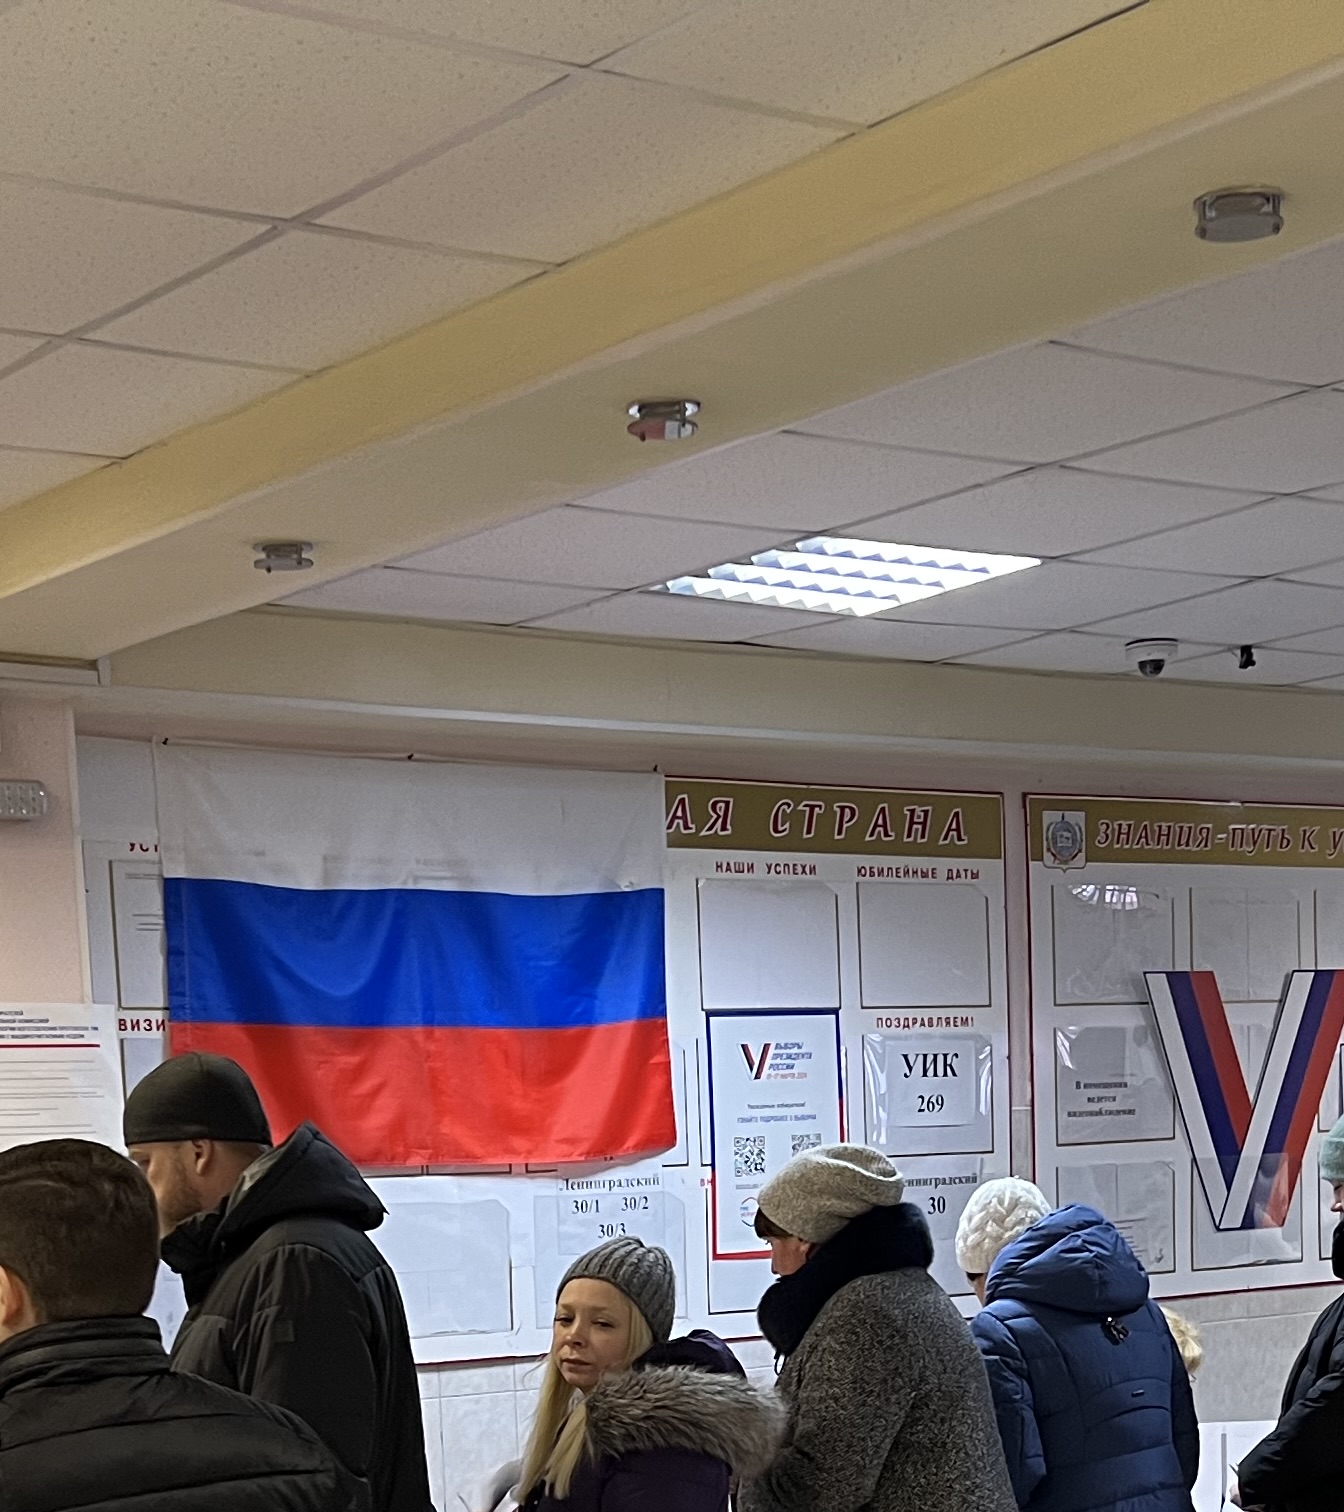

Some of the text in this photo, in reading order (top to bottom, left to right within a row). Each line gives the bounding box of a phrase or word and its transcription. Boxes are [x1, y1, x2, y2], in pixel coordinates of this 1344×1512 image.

[666, 793, 968, 845] АЯ СТРАНА
[1299, 826, 1319, 853] К
[715, 861, 817, 876] НАШИ УСПЕХИ
[856, 864, 980, 881] ЮБИЛЕЙНЫЕ ДАТЫ
[118, 1018, 166, 1032] ВИЗИ
[876, 1016, 974, 1030] ПОЗДРАВЛЯЕМ!
[900, 1053, 959, 1078] УИК
[917, 1094, 944, 1113] 269
[559, 1174, 660, 1192] Ленинградский
[905, 1173, 978, 1190] нинградский
[571, 1196, 649, 1214] 30/1 30/2
[927, 1196, 946, 1215] 30
[598, 1222, 627, 1239] 30/3
